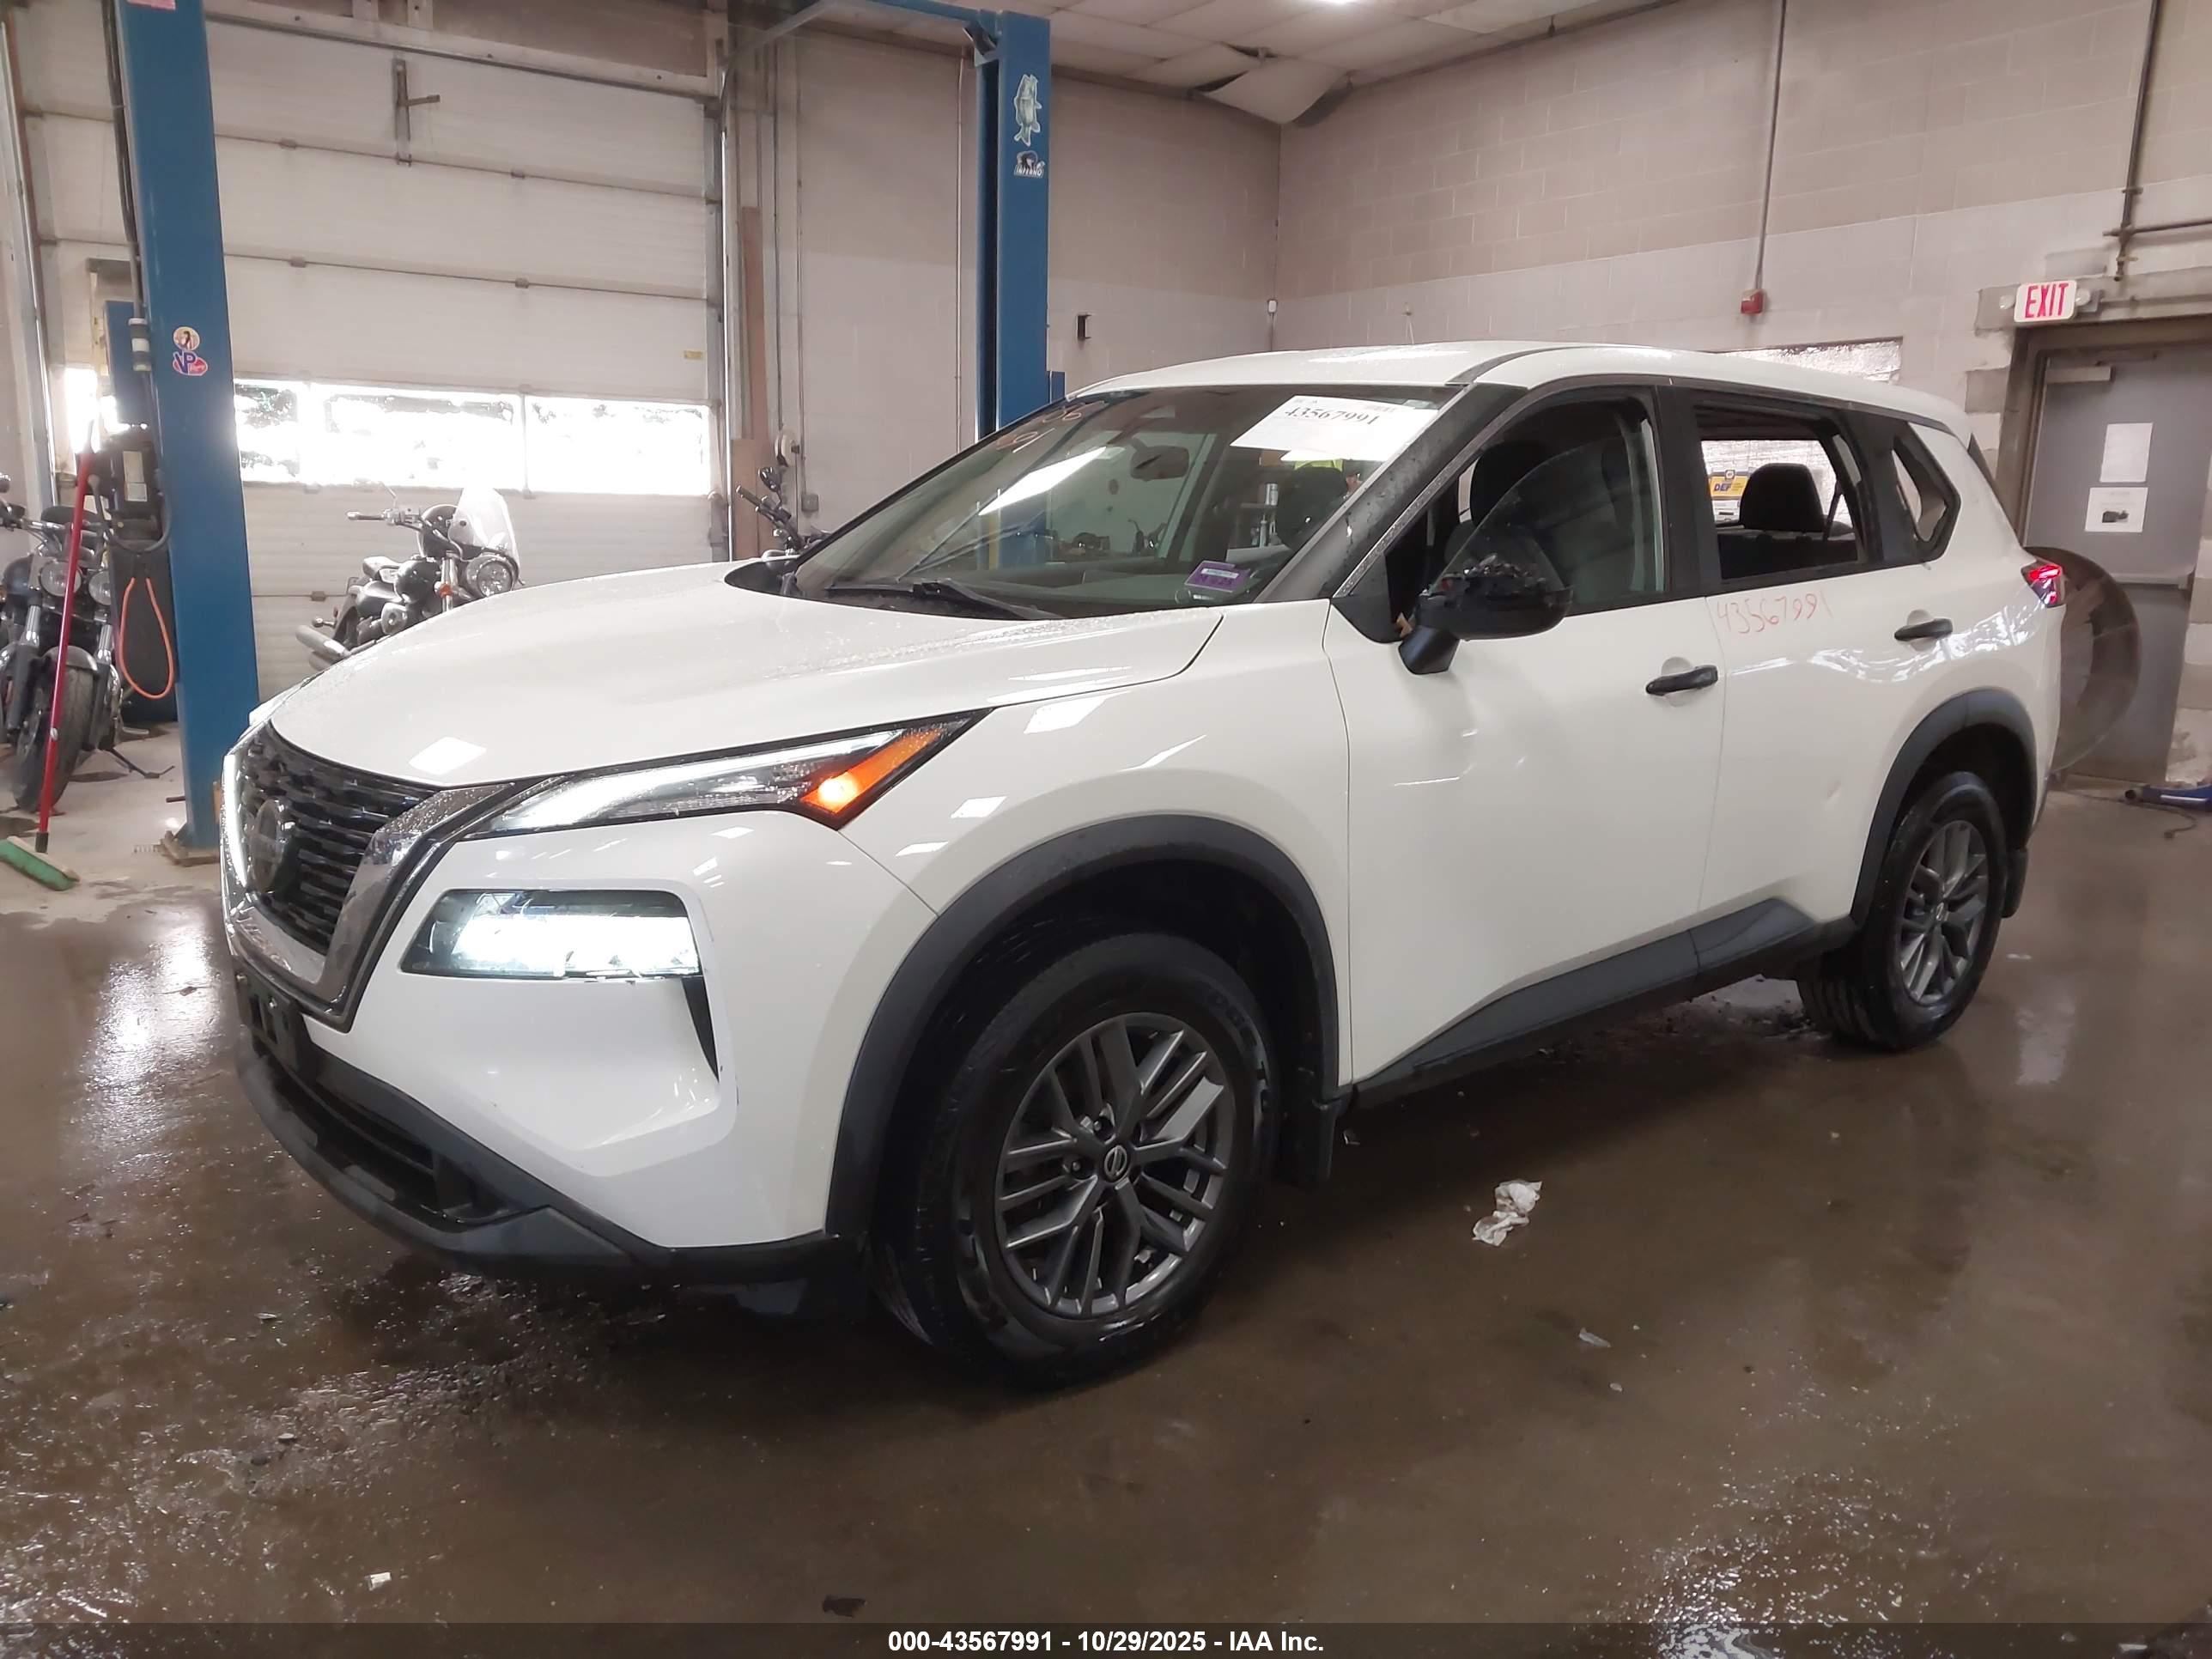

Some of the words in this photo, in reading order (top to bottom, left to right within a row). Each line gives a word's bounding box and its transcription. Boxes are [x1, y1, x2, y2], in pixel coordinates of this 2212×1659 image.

[2025, 283, 2069, 319] EXIT
[1285, 406, 1380, 425] 43567991
[1713, 483, 1732, 492] DEF
[1717, 591, 1834, 634] 43567991
